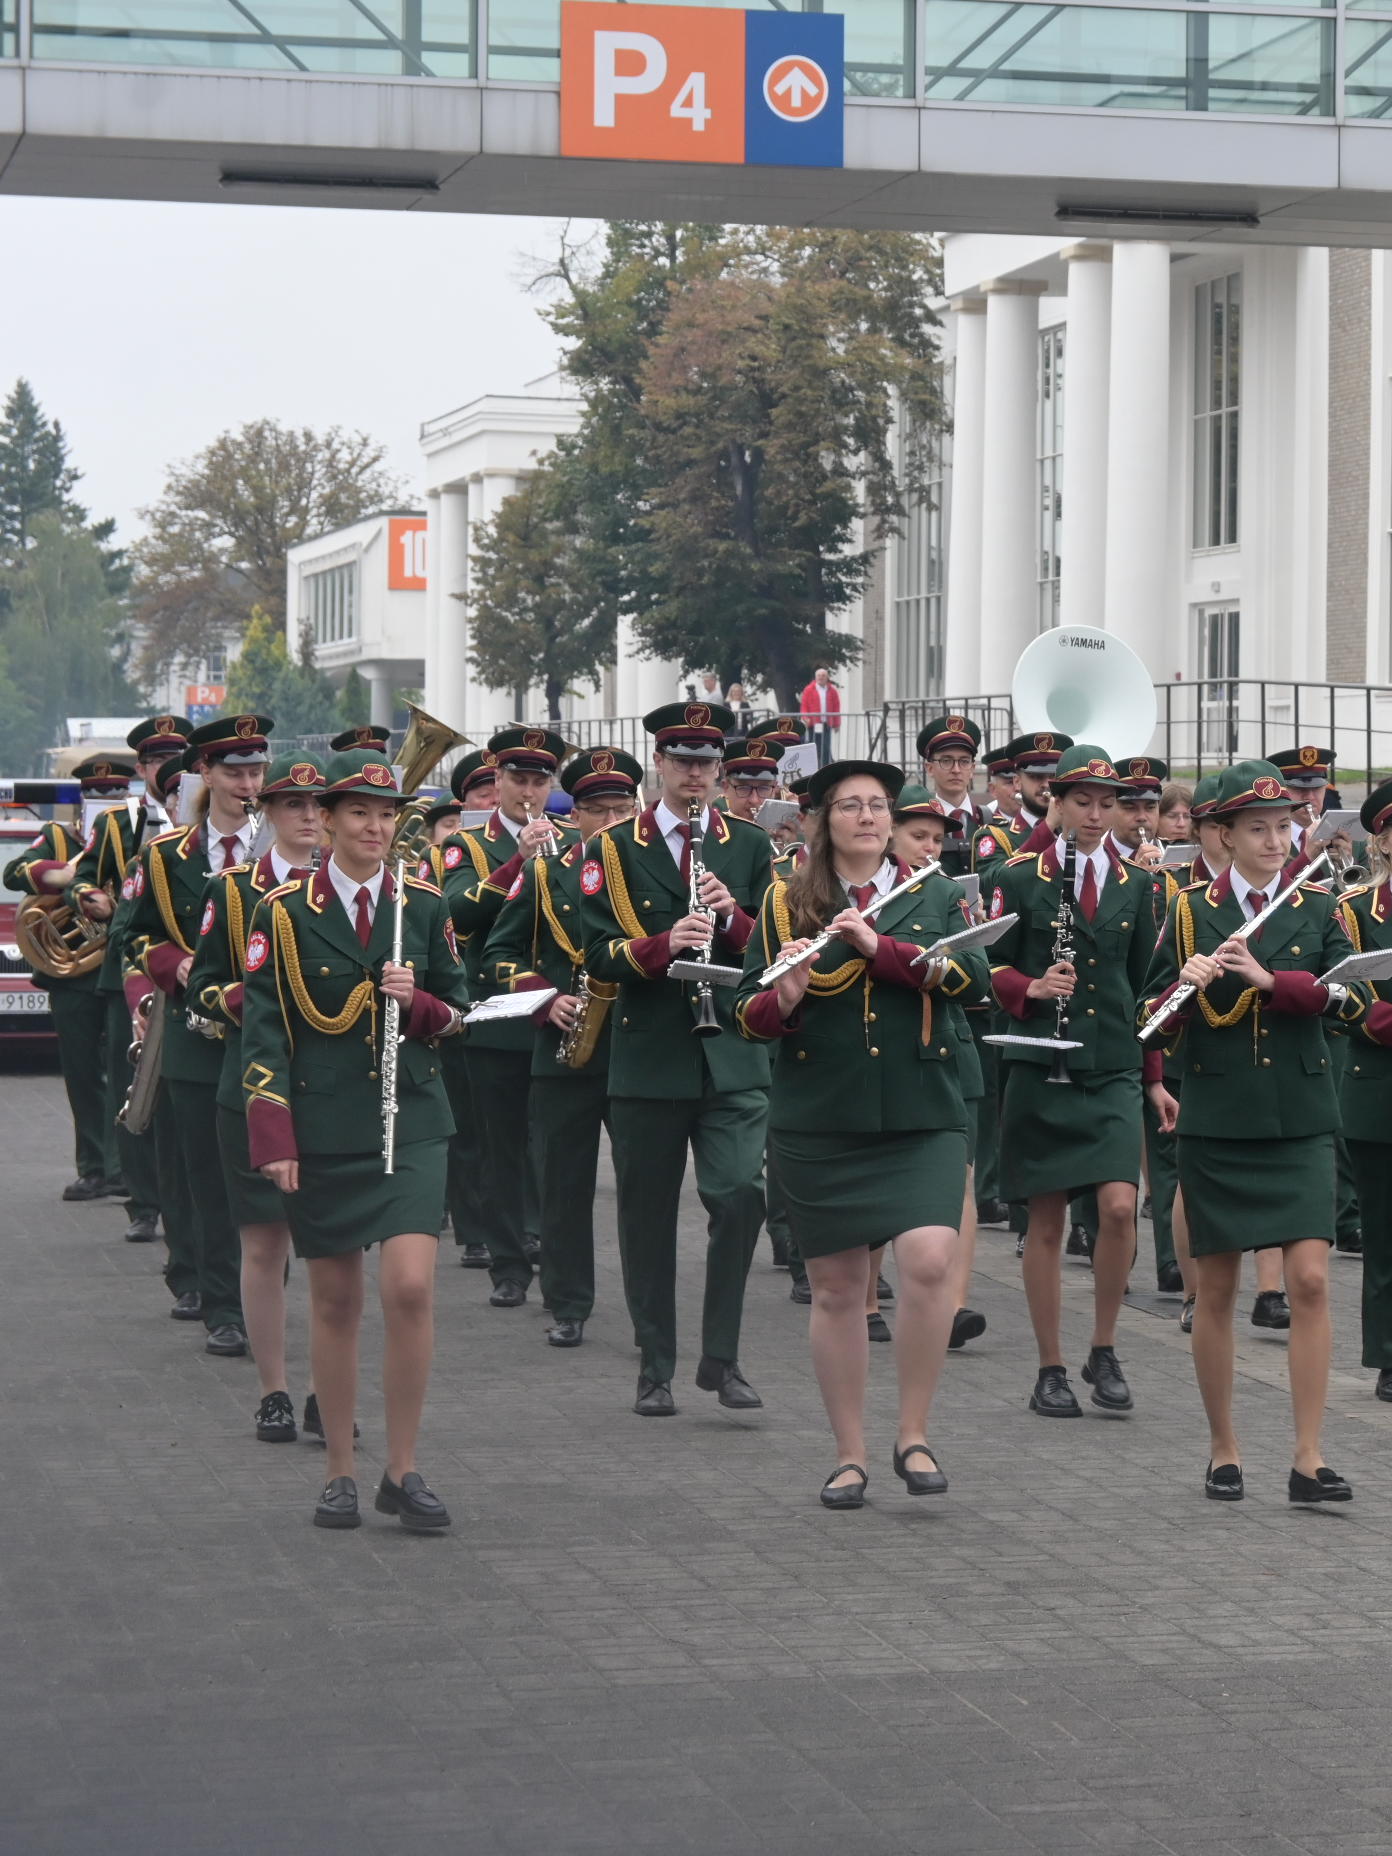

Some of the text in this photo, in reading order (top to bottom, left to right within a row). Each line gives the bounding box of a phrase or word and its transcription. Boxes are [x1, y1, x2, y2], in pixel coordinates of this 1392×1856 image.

[399, 530, 428, 578] 10
[1070, 636, 1105, 650] YAMAHA
[6, 994, 47, 1009] 9189
